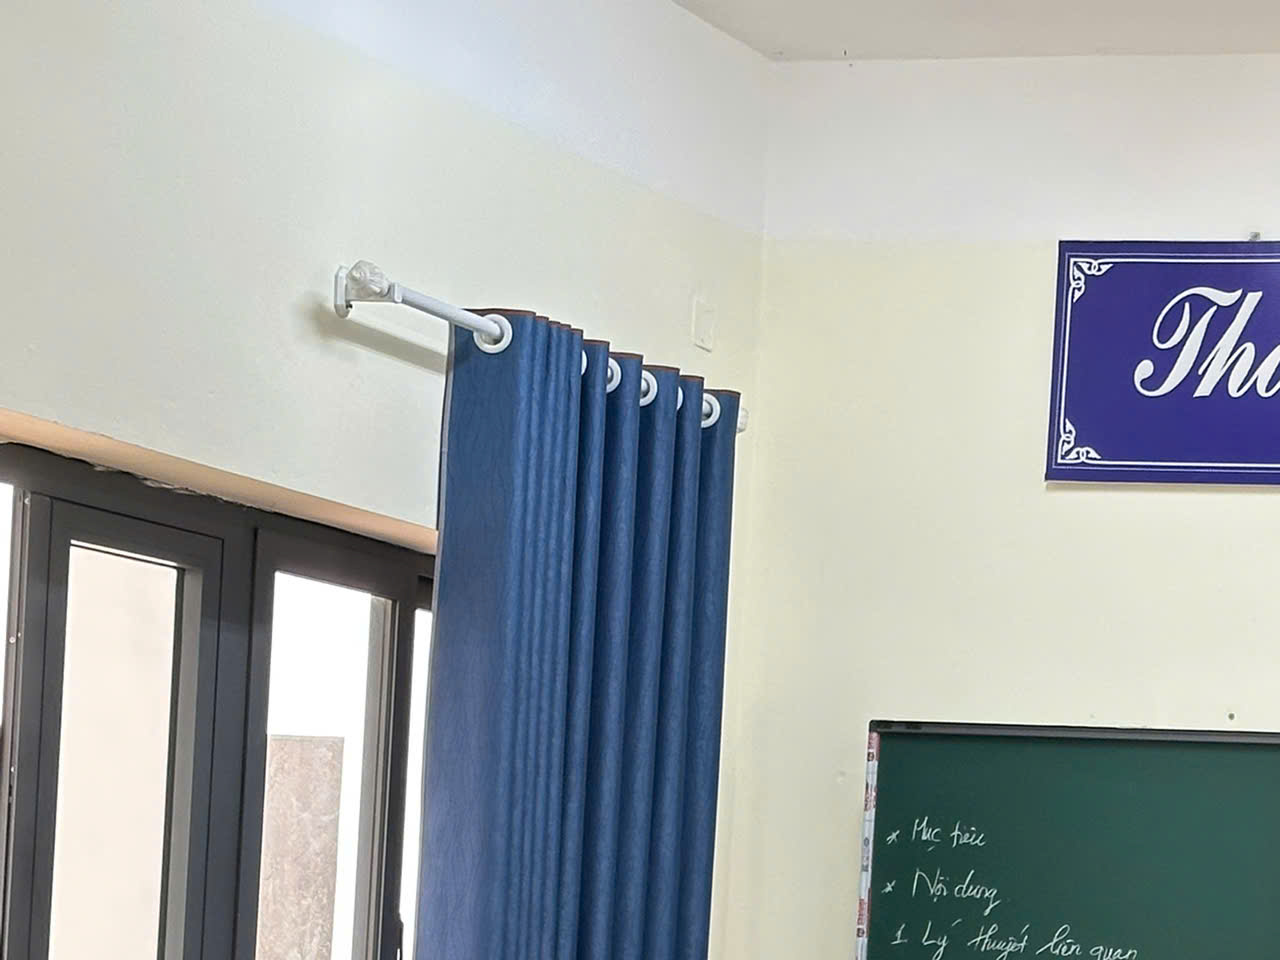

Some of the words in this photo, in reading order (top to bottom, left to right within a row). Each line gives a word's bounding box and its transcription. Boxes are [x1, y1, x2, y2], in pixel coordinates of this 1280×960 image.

[911, 867, 950, 903] Nội
[953, 868, 1003, 917] dung
[1034, 923, 1083, 957] liên
